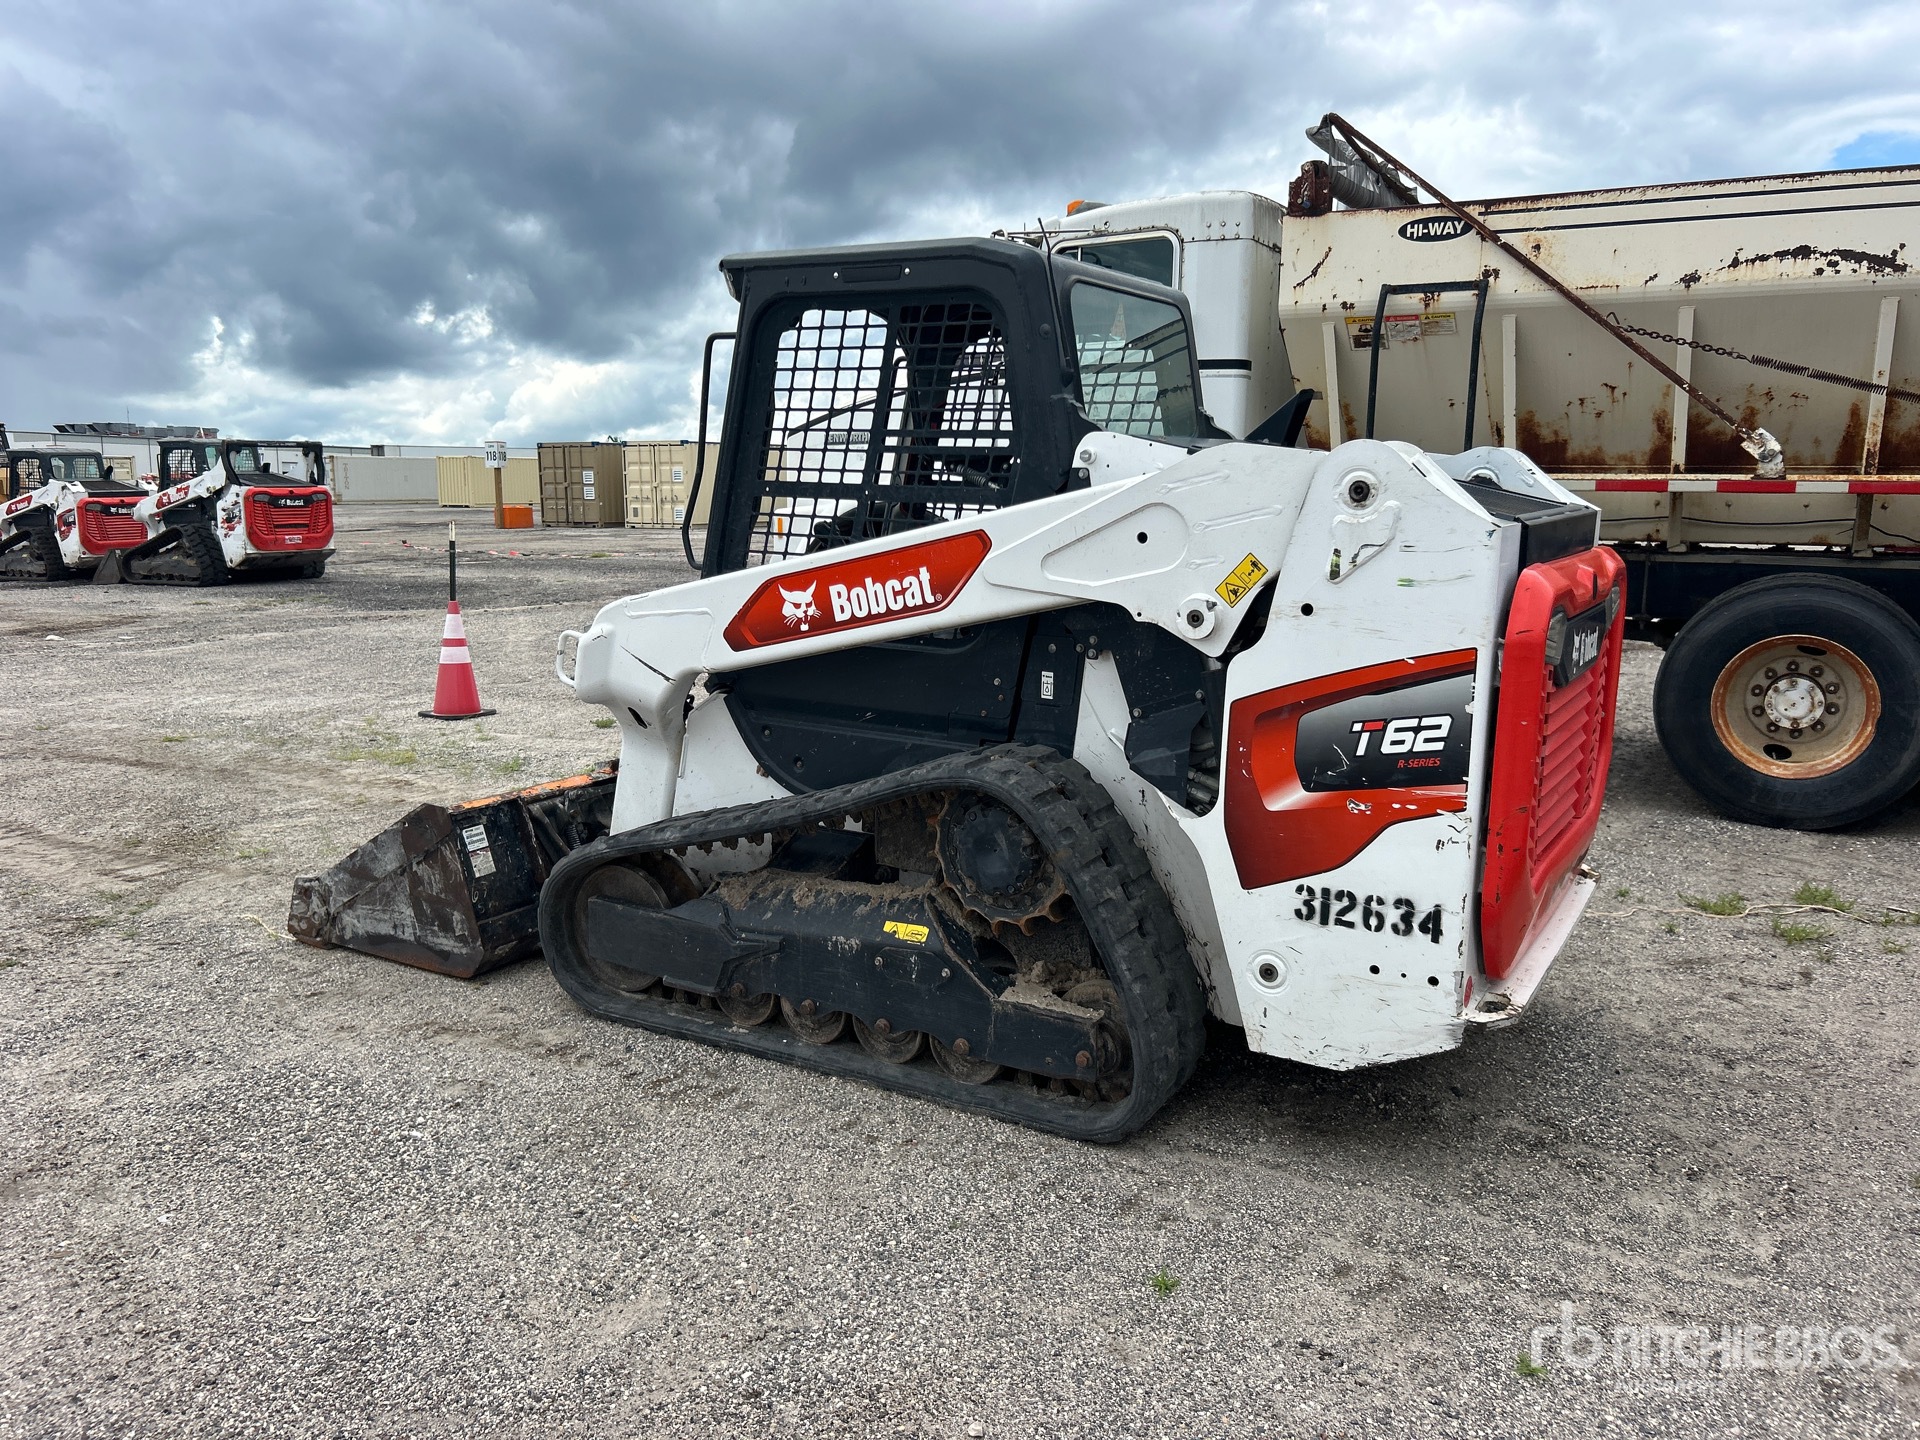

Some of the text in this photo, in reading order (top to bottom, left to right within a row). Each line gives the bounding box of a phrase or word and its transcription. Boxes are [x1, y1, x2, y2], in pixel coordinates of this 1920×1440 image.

[1406, 220, 1465, 239] HI-WAY
[825, 431, 870, 443] ENWRTH
[486, 451, 497, 461] 118
[828, 566, 935, 622] Bobcat
[1351, 715, 1453, 757] T62
[1397, 757, 1441, 769] R-SERIES
[1294, 883, 1444, 944] 312634
